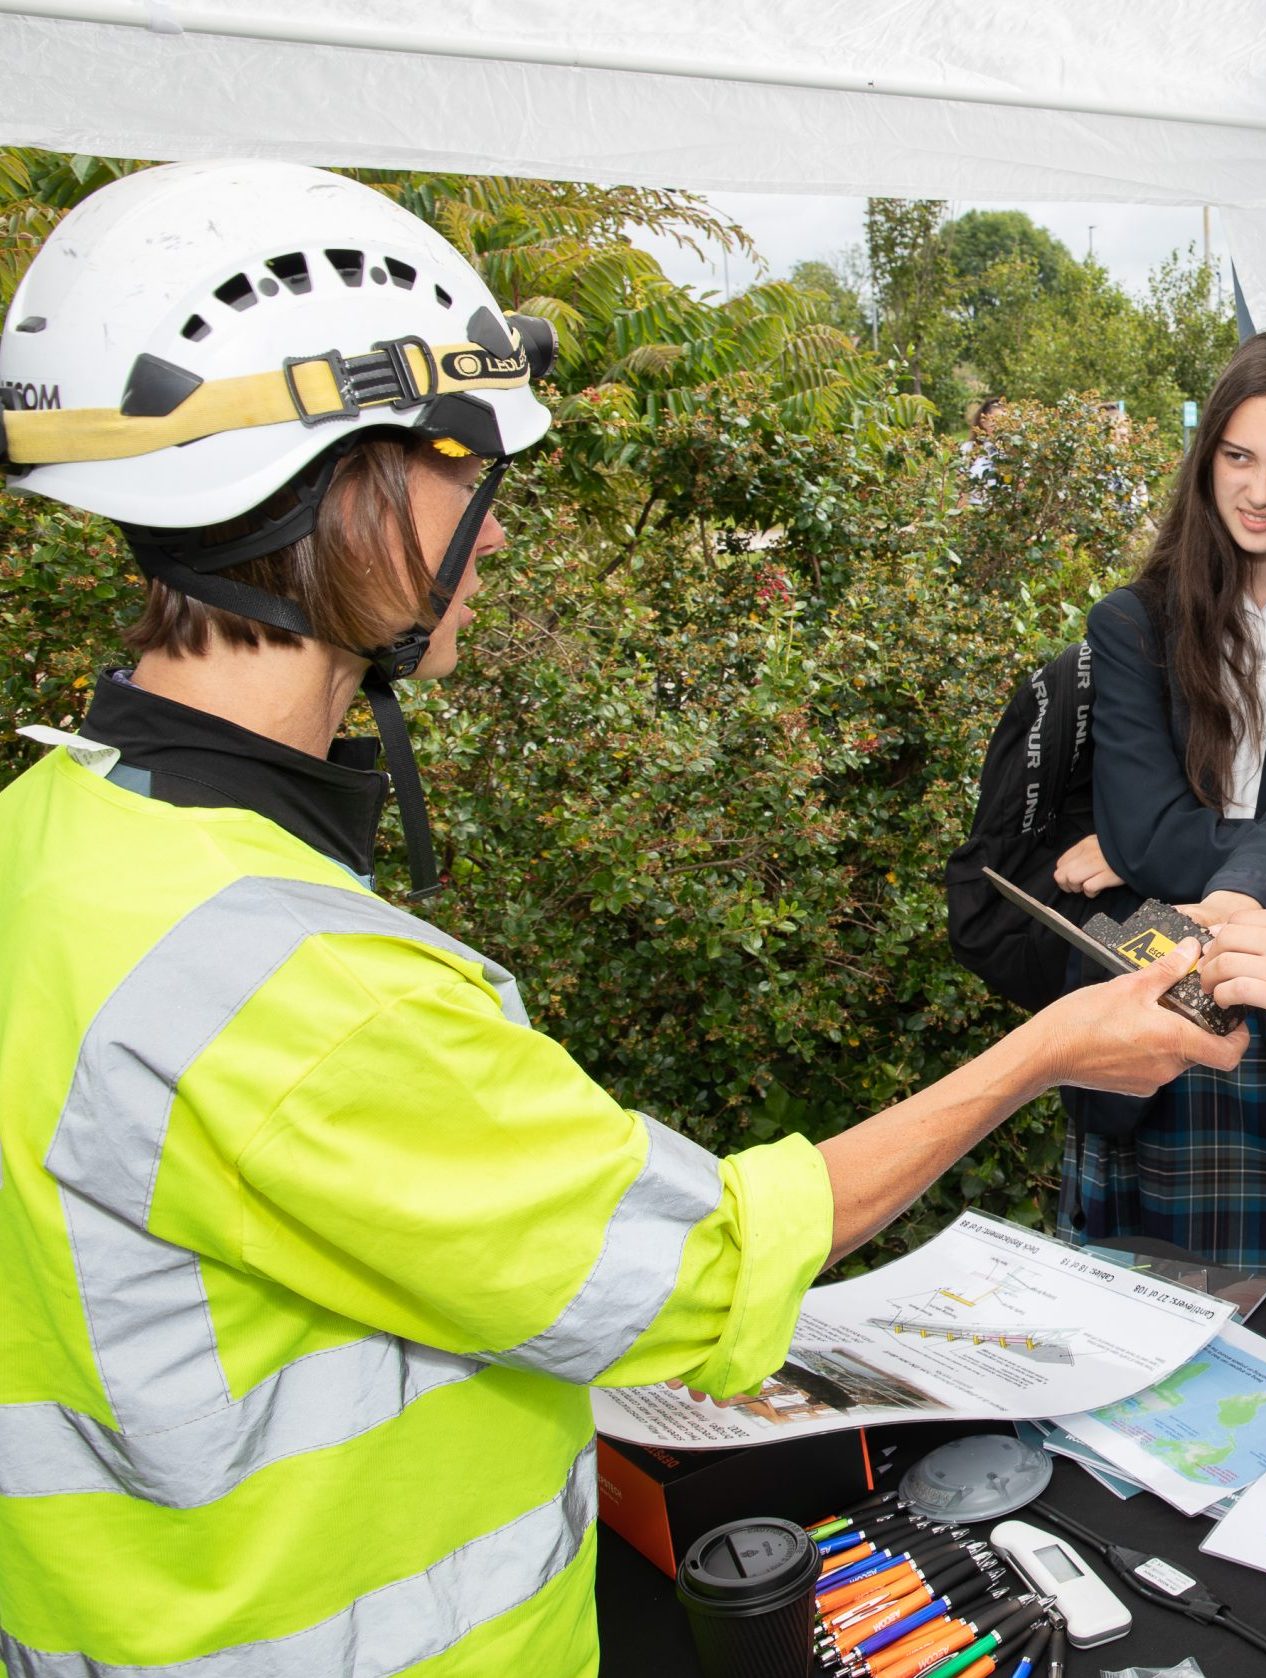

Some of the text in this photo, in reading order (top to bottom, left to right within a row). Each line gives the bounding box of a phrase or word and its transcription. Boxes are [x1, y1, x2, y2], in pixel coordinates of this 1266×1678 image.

[967, 1221, 977, 1231] of
[980, 1225, 1024, 1250] Replacement:
[1021, 1241, 1040, 1256] Deck
[1059, 1256, 1115, 1284] Cables: 18 of 18
[1132, 1282, 1215, 1321] Cantilevers: 27 of 108
[872, 1609, 901, 1633] AECOM
[918, 1644, 950, 1670] AECOM
